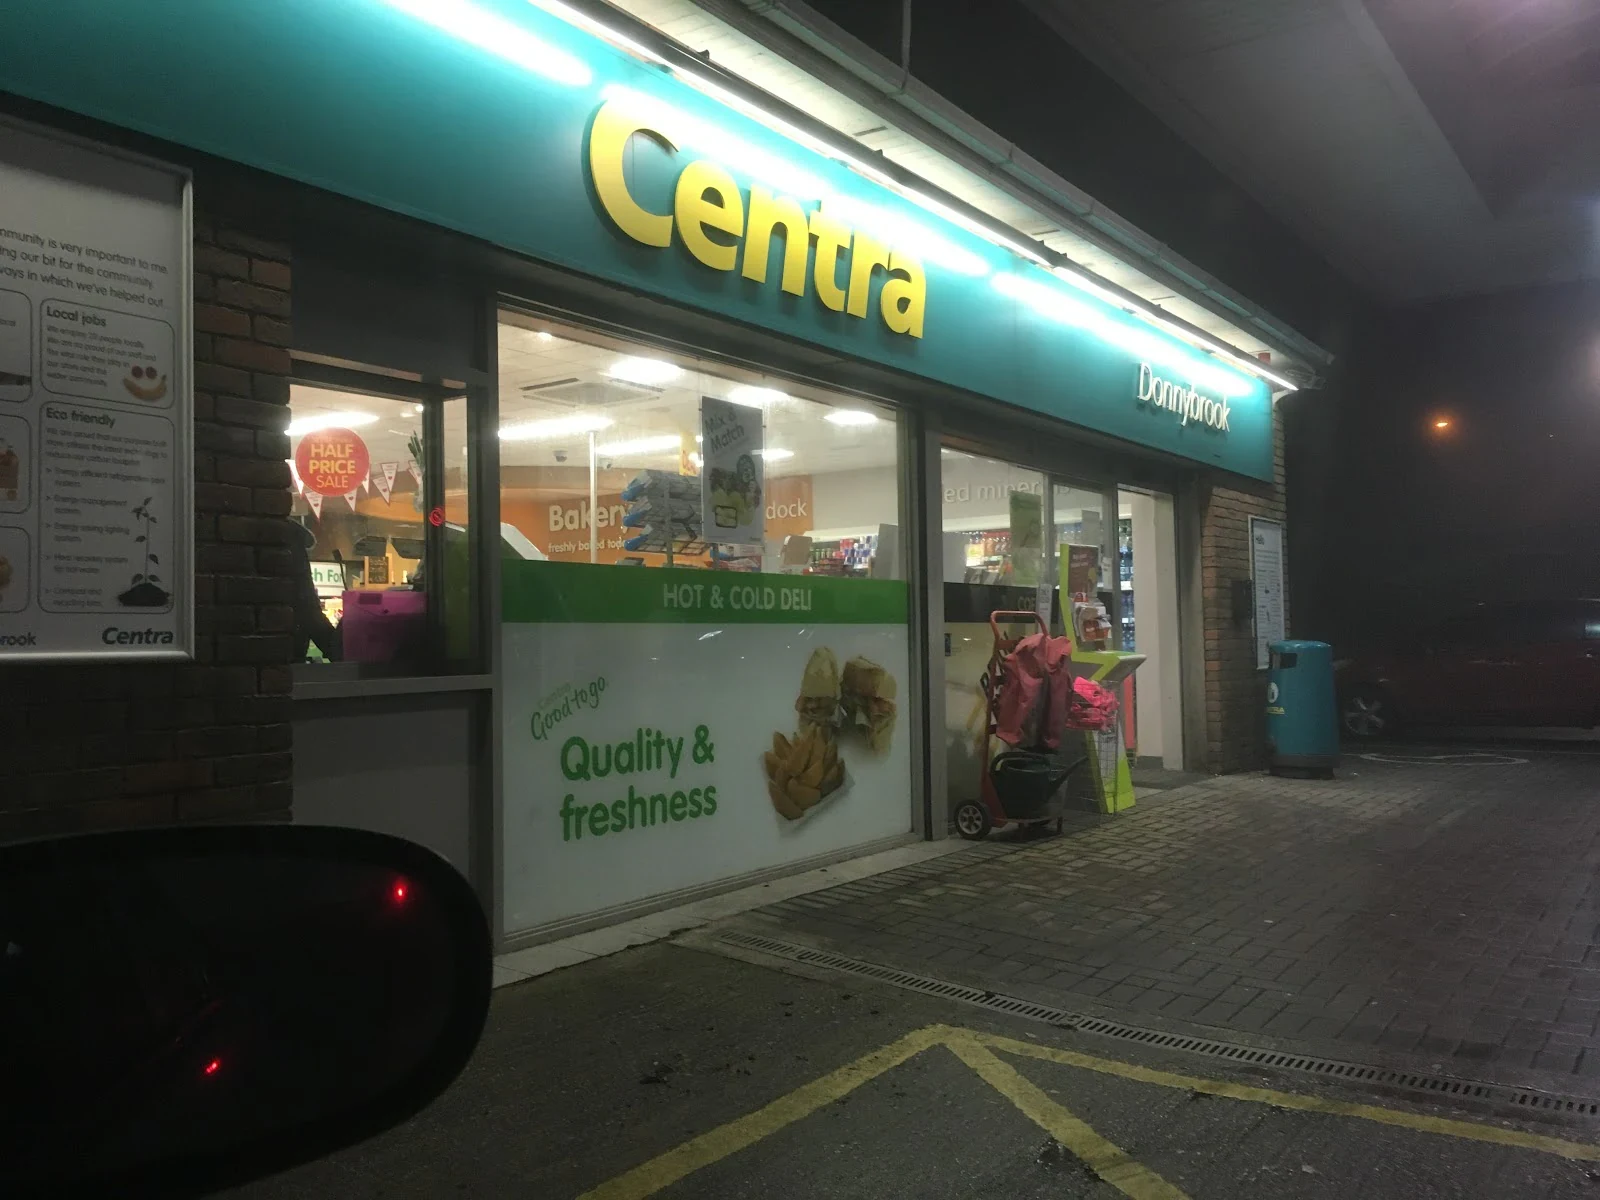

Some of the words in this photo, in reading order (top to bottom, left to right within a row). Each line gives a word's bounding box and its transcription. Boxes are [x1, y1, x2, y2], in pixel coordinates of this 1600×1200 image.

[588, 96, 928, 339] Centra
[20, 251, 39, 262] our
[42, 254, 56, 266] bit
[59, 257, 73, 270] for
[77, 262, 93, 275] the
[48, 238, 57, 248] is
[60, 241, 82, 256] very
[85, 246, 136, 265] important
[138, 259, 149, 270] to
[27, 269, 37, 281] in
[40, 272, 73, 288] which
[110, 286, 145, 304] helped
[47, 306, 78, 321] Local
[82, 310, 107, 327] jobs
[1138, 362, 1231, 432] Donnybrook
[46, 407, 68, 420] Eco
[72, 410, 116, 428] friendly
[704, 413, 725, 435] Mix
[311, 443, 354, 458] HALF
[710, 424, 745, 454] Match
[308, 459, 356, 474] PRICE
[316, 475, 349, 488] SALE
[548, 502, 632, 534] Bakery
[548, 541, 576, 554] freshly
[579, 539, 605, 551] baed
[663, 584, 704, 609] HOT
[710, 585, 724, 609] &
[729, 586, 776, 610] COLD
[780, 587, 812, 612] DELI
[102, 627, 173, 645] Centra
[531, 696, 573, 741] Good
[571, 688, 588, 709] to
[560, 727, 684, 781] Quality
[692, 725, 715, 764] &
[559, 784, 717, 842] freshness
